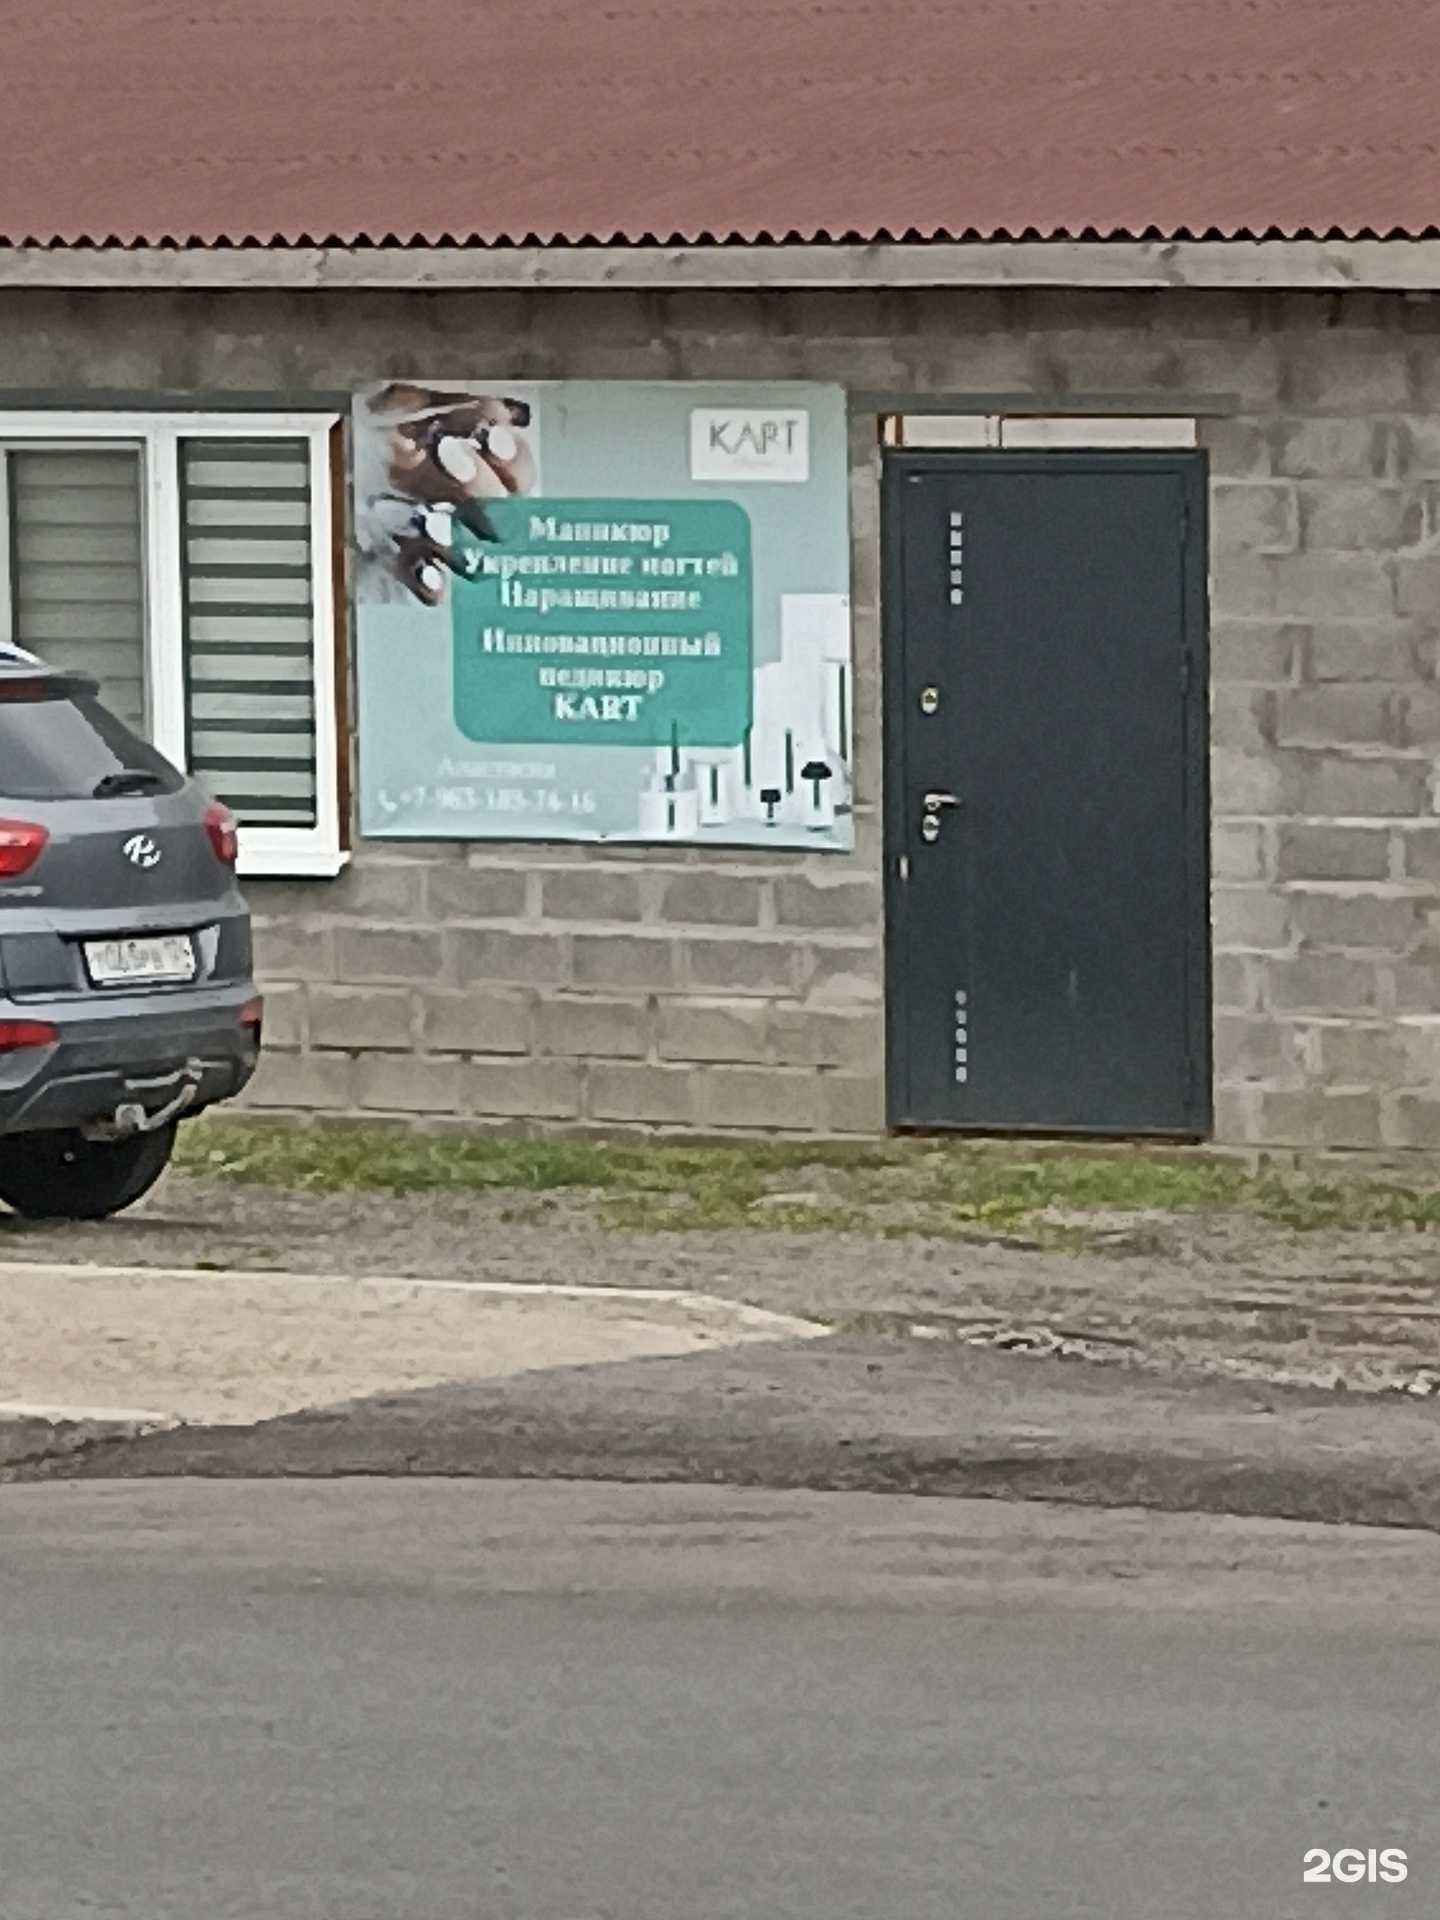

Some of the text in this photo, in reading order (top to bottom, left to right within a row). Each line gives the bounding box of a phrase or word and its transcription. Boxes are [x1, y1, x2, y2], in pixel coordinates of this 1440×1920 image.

[709, 419, 800, 455] KART
[530, 515, 671, 548] Маникюр
[463, 549, 739, 580] Укрепление ногтей
[501, 579, 702, 613] Наращивание
[483, 627, 722, 657] Инновационный
[539, 667, 666, 693] педикюр
[554, 691, 643, 721] KART
